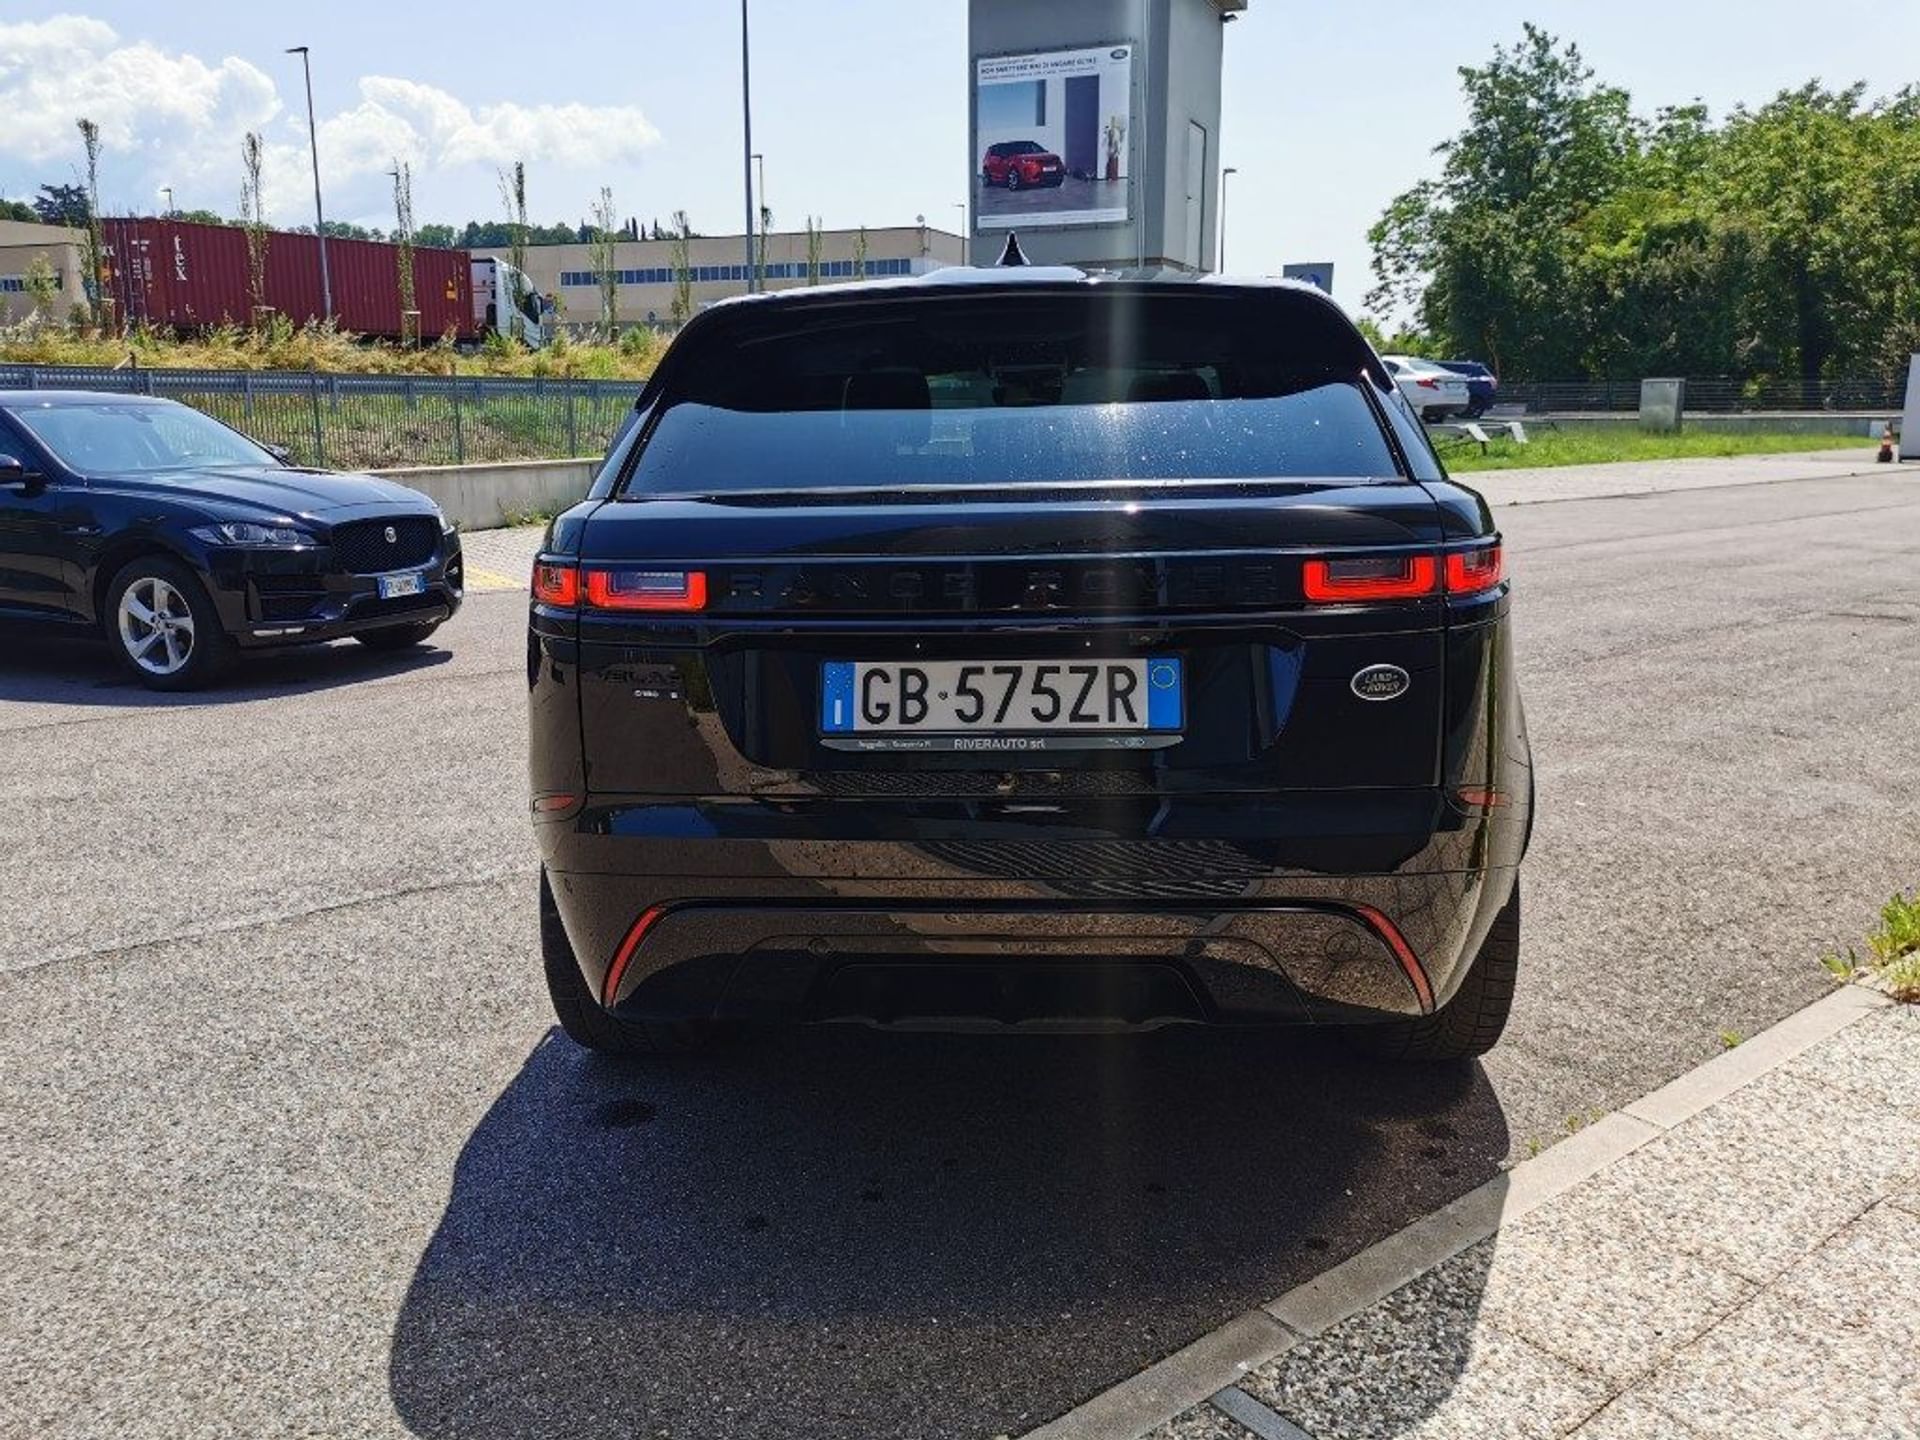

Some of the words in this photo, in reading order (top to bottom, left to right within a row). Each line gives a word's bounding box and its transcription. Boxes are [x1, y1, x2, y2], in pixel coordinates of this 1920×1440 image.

[862, 668, 929, 725] GB
[954, 665, 1138, 724] 575ZR
[954, 738, 1028, 750] RIVERAUTO
